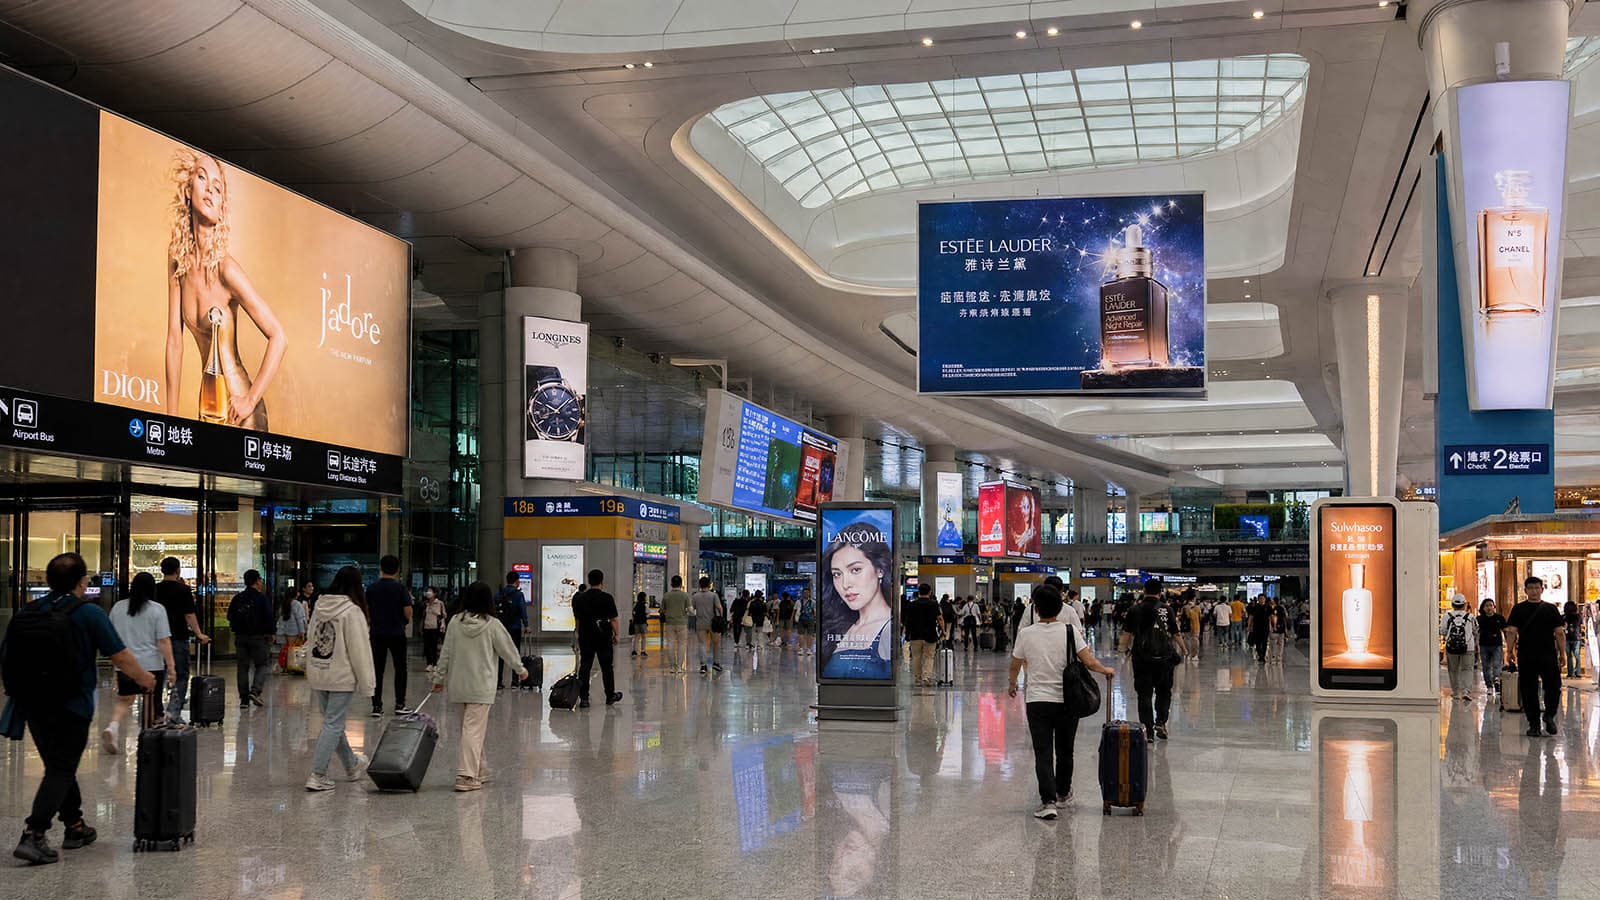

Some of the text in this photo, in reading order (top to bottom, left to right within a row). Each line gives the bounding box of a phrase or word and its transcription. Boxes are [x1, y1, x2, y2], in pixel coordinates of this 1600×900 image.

[989, 238, 1052, 253] LAUDER
[1498, 245, 1531, 253] CHANEL
[532, 331, 582, 345] LONGINES
[101, 369, 161, 406] DIOR
[13, 428, 55, 443] Airport Bus
[168, 425, 193, 445] 地铁
[146, 446, 165, 457] Metro
[262, 441, 292, 461] 停车场
[342, 455, 377, 474] 长途汽车
[1493, 448, 1508, 469] 2
[245, 460, 266, 472] Parking
[327, 472, 339, 482] Long
[512, 500, 535, 514] 18B
[599, 499, 625, 513] 19B
[1330, 521, 1383, 533] Sulwhasoo
[827, 529, 888, 543] LANCÔME
